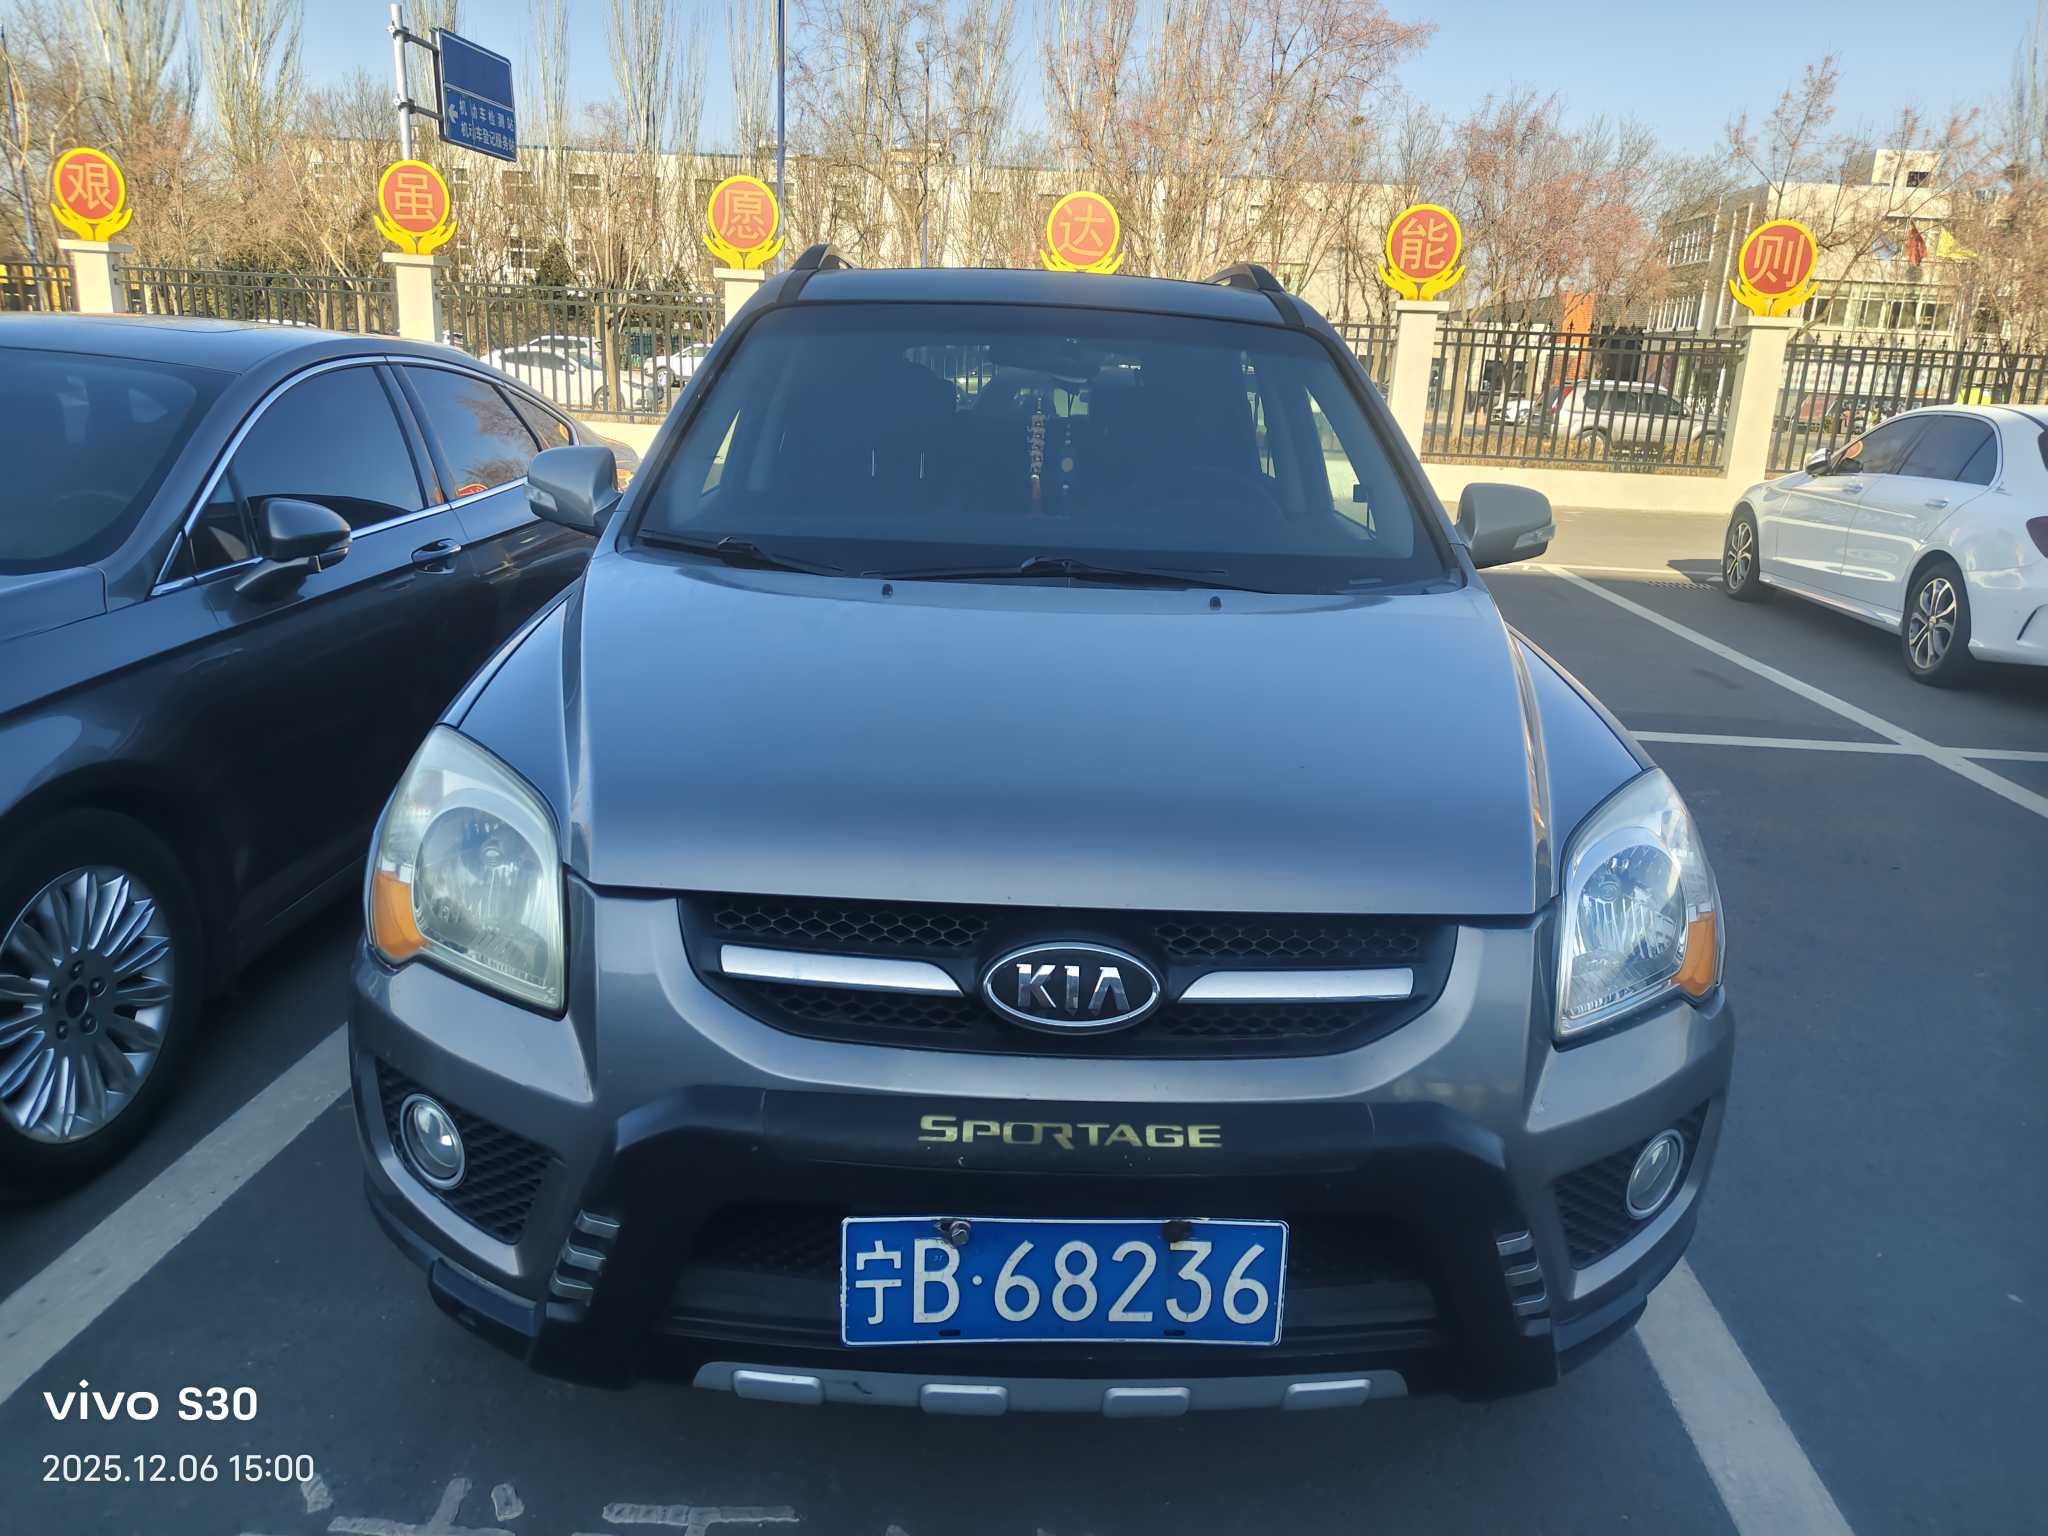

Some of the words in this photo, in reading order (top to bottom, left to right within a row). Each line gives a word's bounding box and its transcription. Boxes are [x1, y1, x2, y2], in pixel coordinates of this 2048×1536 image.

[65, 161, 114, 212] 艰
[393, 172, 437, 224] 虽
[719, 188, 767, 241] 愿
[1057, 202, 1107, 257] 达
[1398, 216, 1450, 271] 能
[1749, 233, 1806, 288] 则
[1015, 962, 1132, 1014] KIA
[917, 1114, 1223, 1151] SPORTAGE
[855, 1237, 1269, 1326] 宁B·68236
